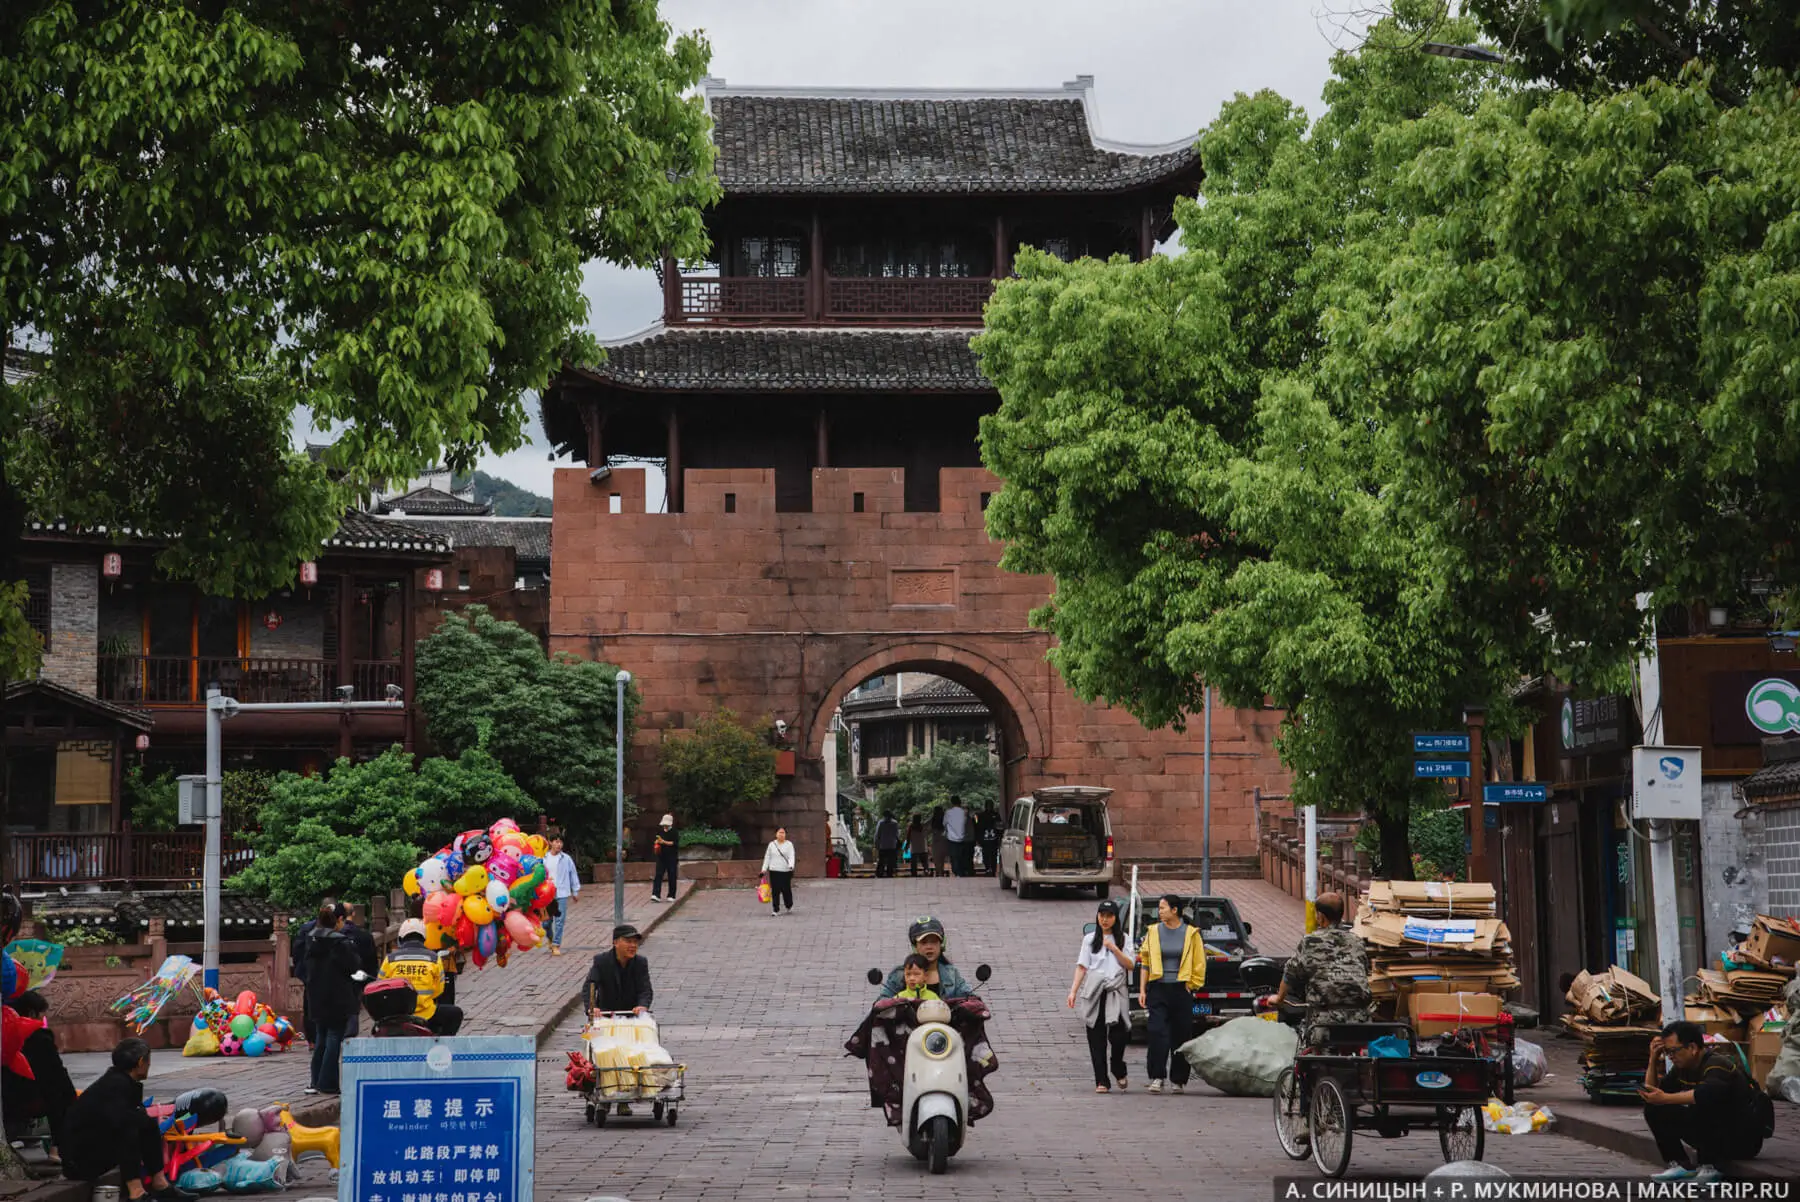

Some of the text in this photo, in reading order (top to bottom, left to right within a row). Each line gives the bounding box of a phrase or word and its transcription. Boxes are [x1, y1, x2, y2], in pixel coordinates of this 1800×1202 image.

[383, 1098, 494, 1118] 温馨提示
[404, 1145, 499, 1160] 此路段严禁停
